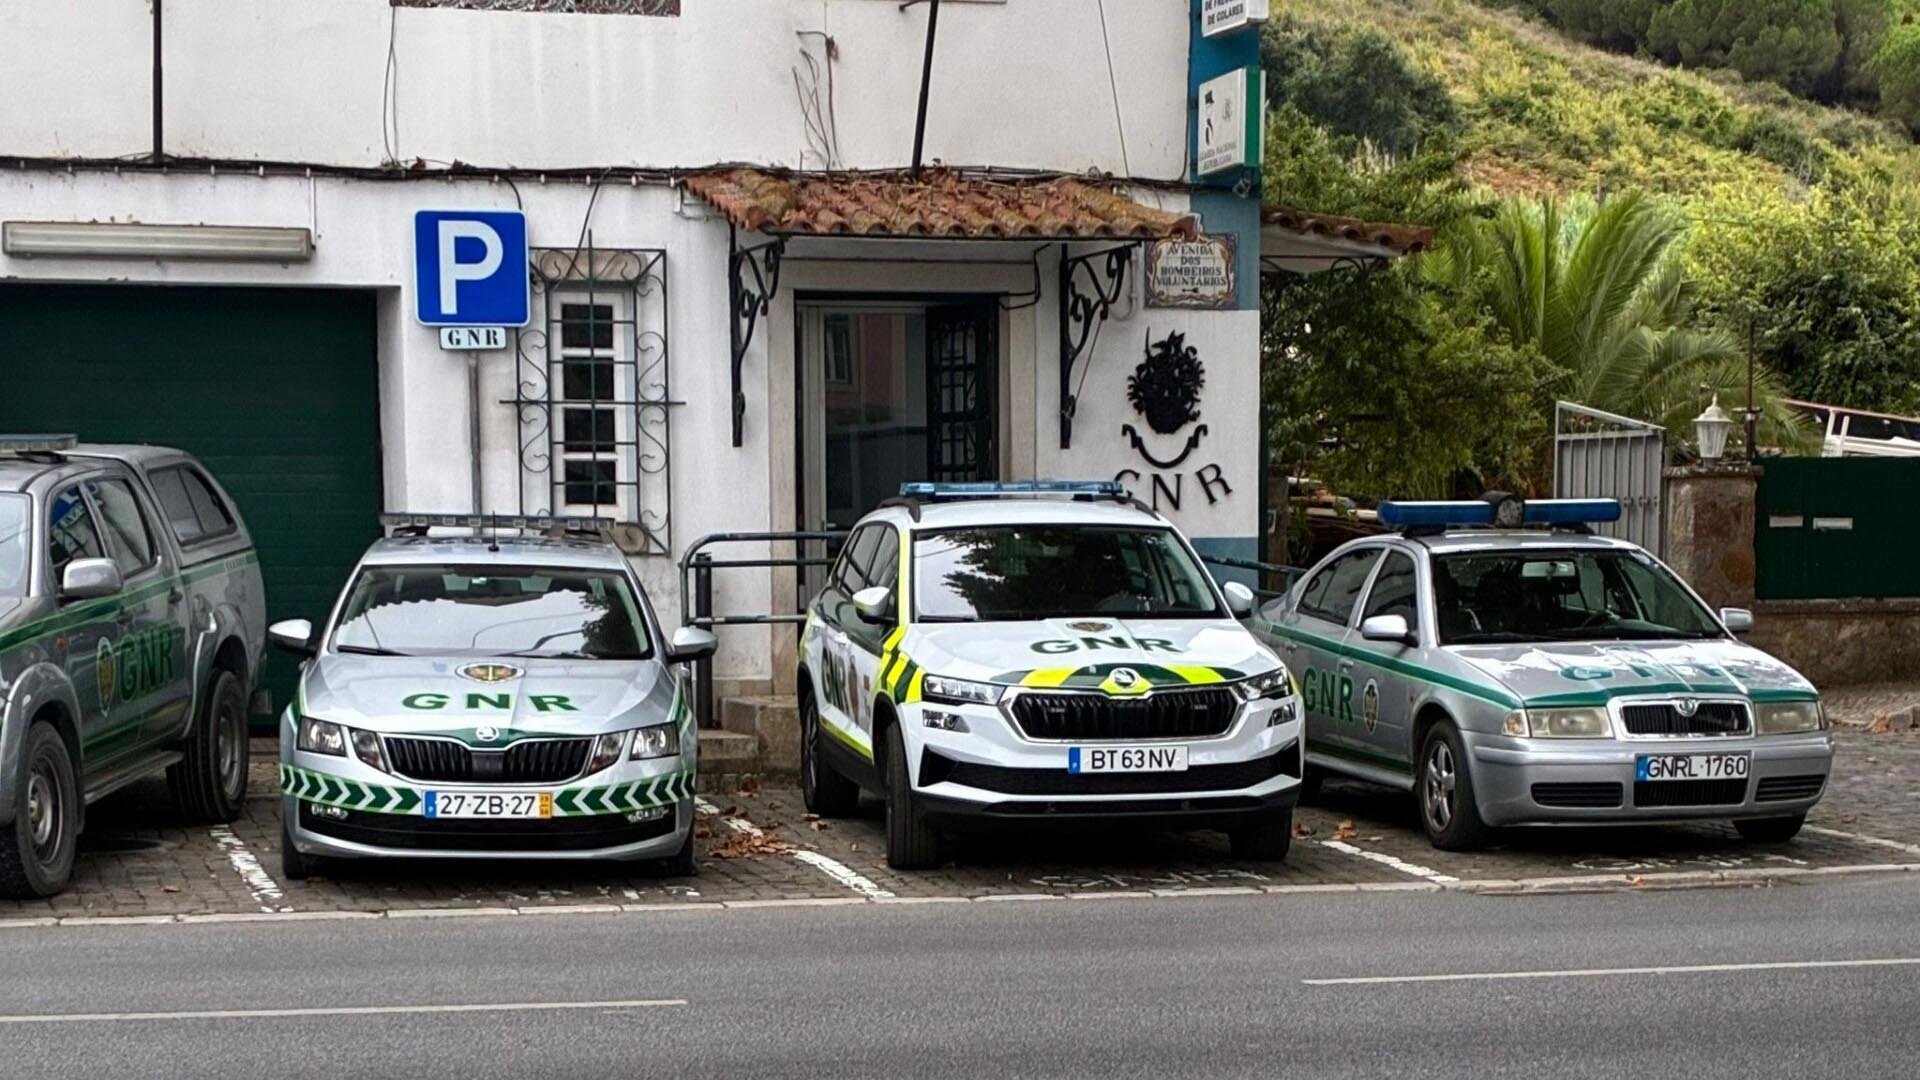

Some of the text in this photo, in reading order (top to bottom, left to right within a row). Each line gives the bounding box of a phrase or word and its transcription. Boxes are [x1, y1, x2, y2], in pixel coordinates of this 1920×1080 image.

[1207, 13, 1215, 25] DE
[1167, 245, 1214, 255] AVENIDA
[438, 219, 504, 315] P
[1181, 256, 1201, 266] DOS
[1160, 266, 1222, 277] BOMBEIROS
[447, 329, 499, 346] GNR
[1029, 636, 1184, 654] GNR
[119, 624, 175, 702] GNR
[820, 645, 850, 717] GNR
[401, 692, 580, 712] GNR
[1302, 666, 1355, 722] GNR
